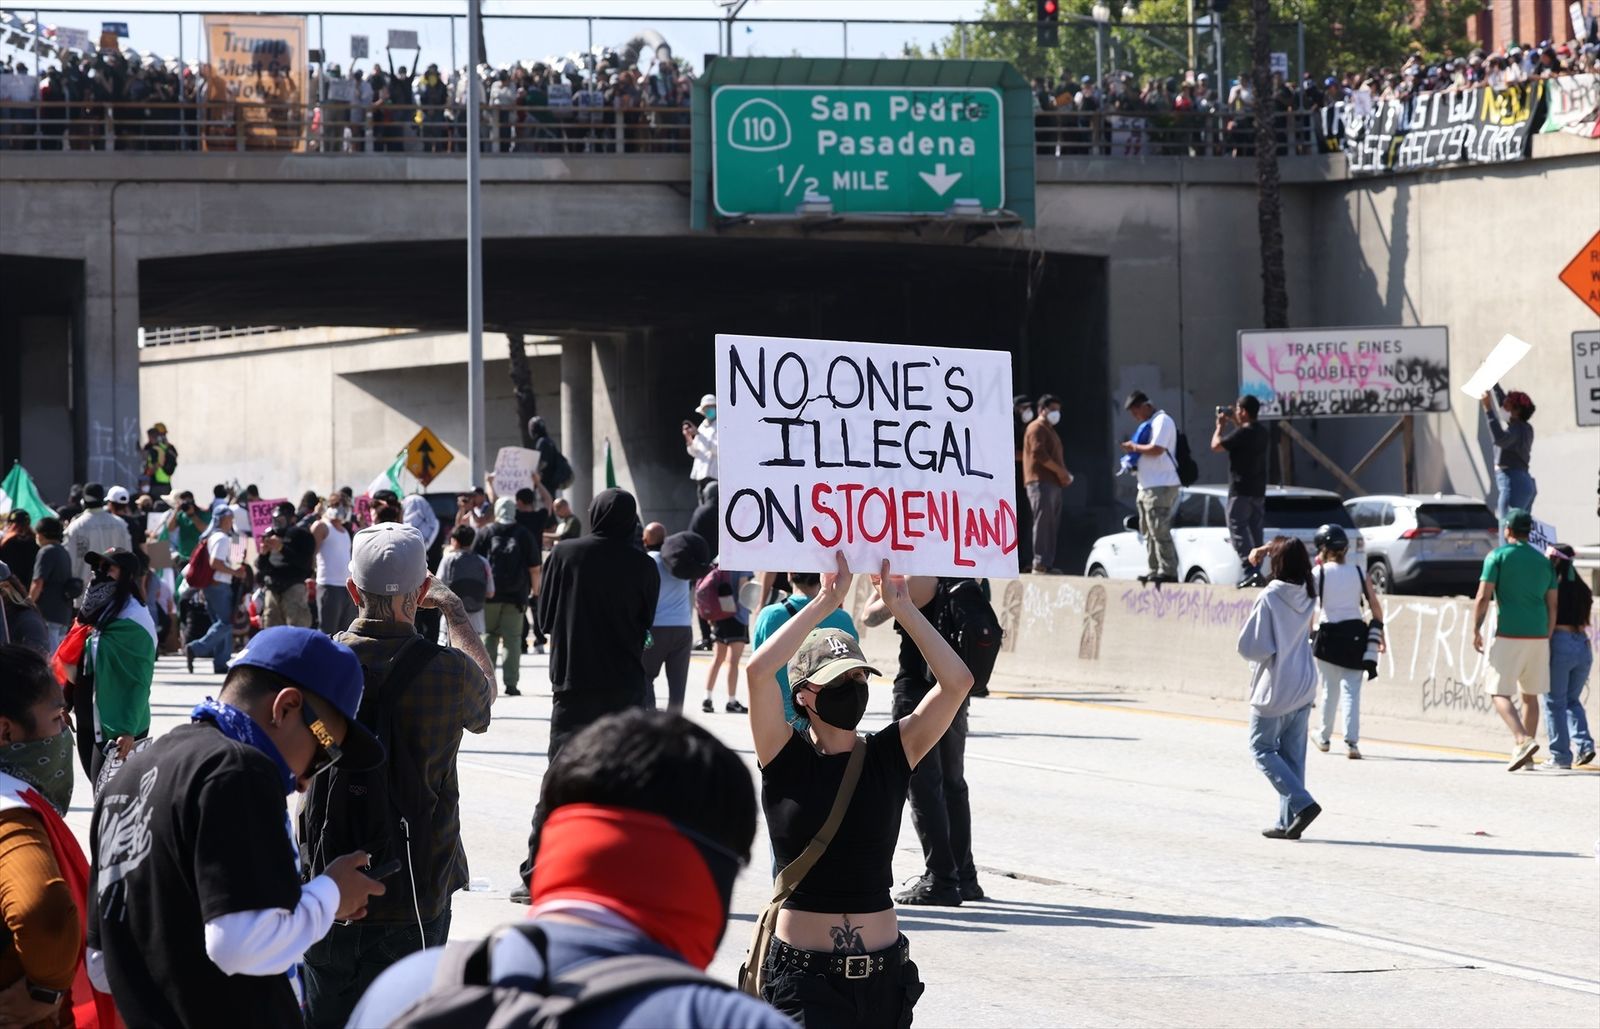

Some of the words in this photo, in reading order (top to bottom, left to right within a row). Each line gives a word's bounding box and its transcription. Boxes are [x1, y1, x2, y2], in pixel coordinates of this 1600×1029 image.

[811, 96, 871, 121] San
[890, 96, 982, 122] Pedro
[743, 117, 776, 142] 110
[818, 131, 976, 156] Pasadena
[777, 164, 819, 197] 1/2
[833, 171, 889, 190] MILE
[1287, 342, 1348, 357] TRAFFIC
[1358, 340, 1403, 354] FINES
[730, 344, 809, 409] NO
[827, 355, 974, 412] ONE'S
[1296, 364, 1369, 380] DOUBLED
[1378, 364, 1394, 377] IN
[759, 417, 994, 480] ILLEGAL
[725, 484, 804, 542] ON
[811, 482, 949, 551] STOLEN
[952, 490, 1018, 567] LAND
[825, 635, 850, 655] LA
